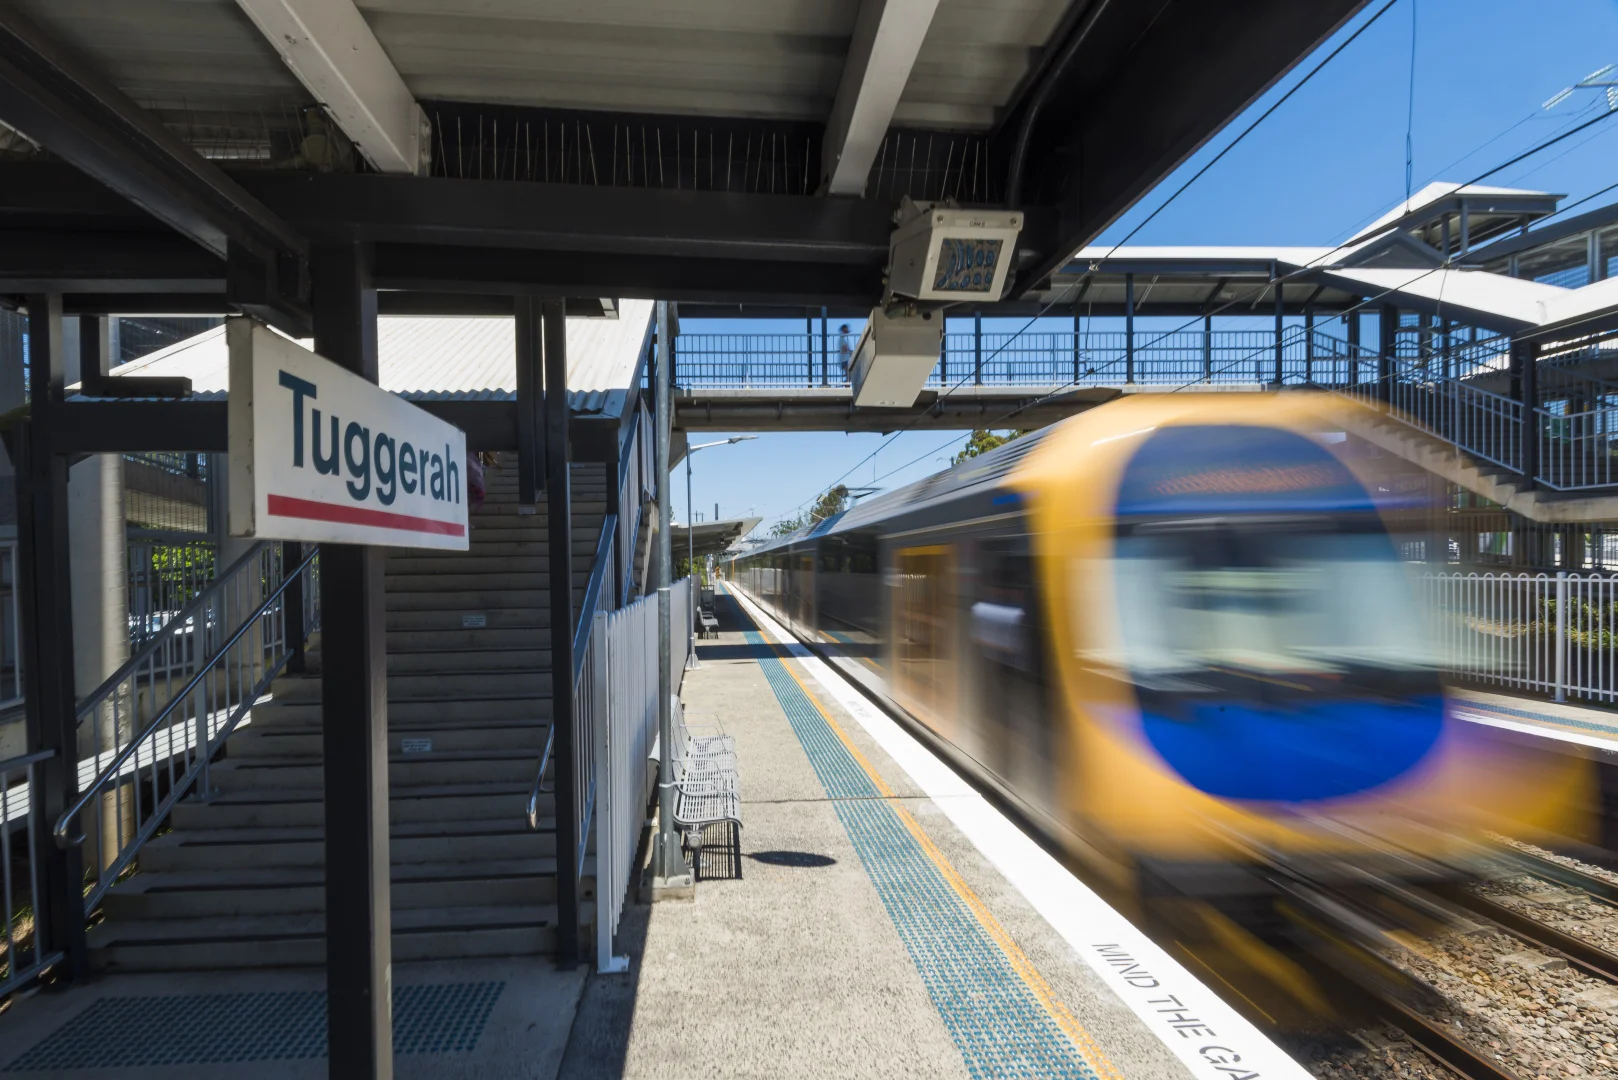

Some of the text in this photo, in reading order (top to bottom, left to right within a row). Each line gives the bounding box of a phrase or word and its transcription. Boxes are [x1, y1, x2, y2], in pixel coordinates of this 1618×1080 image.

[279, 370, 460, 506] Tuggerah
[1092, 943, 1160, 988] MIND
[1147, 994, 1217, 1038] THE
